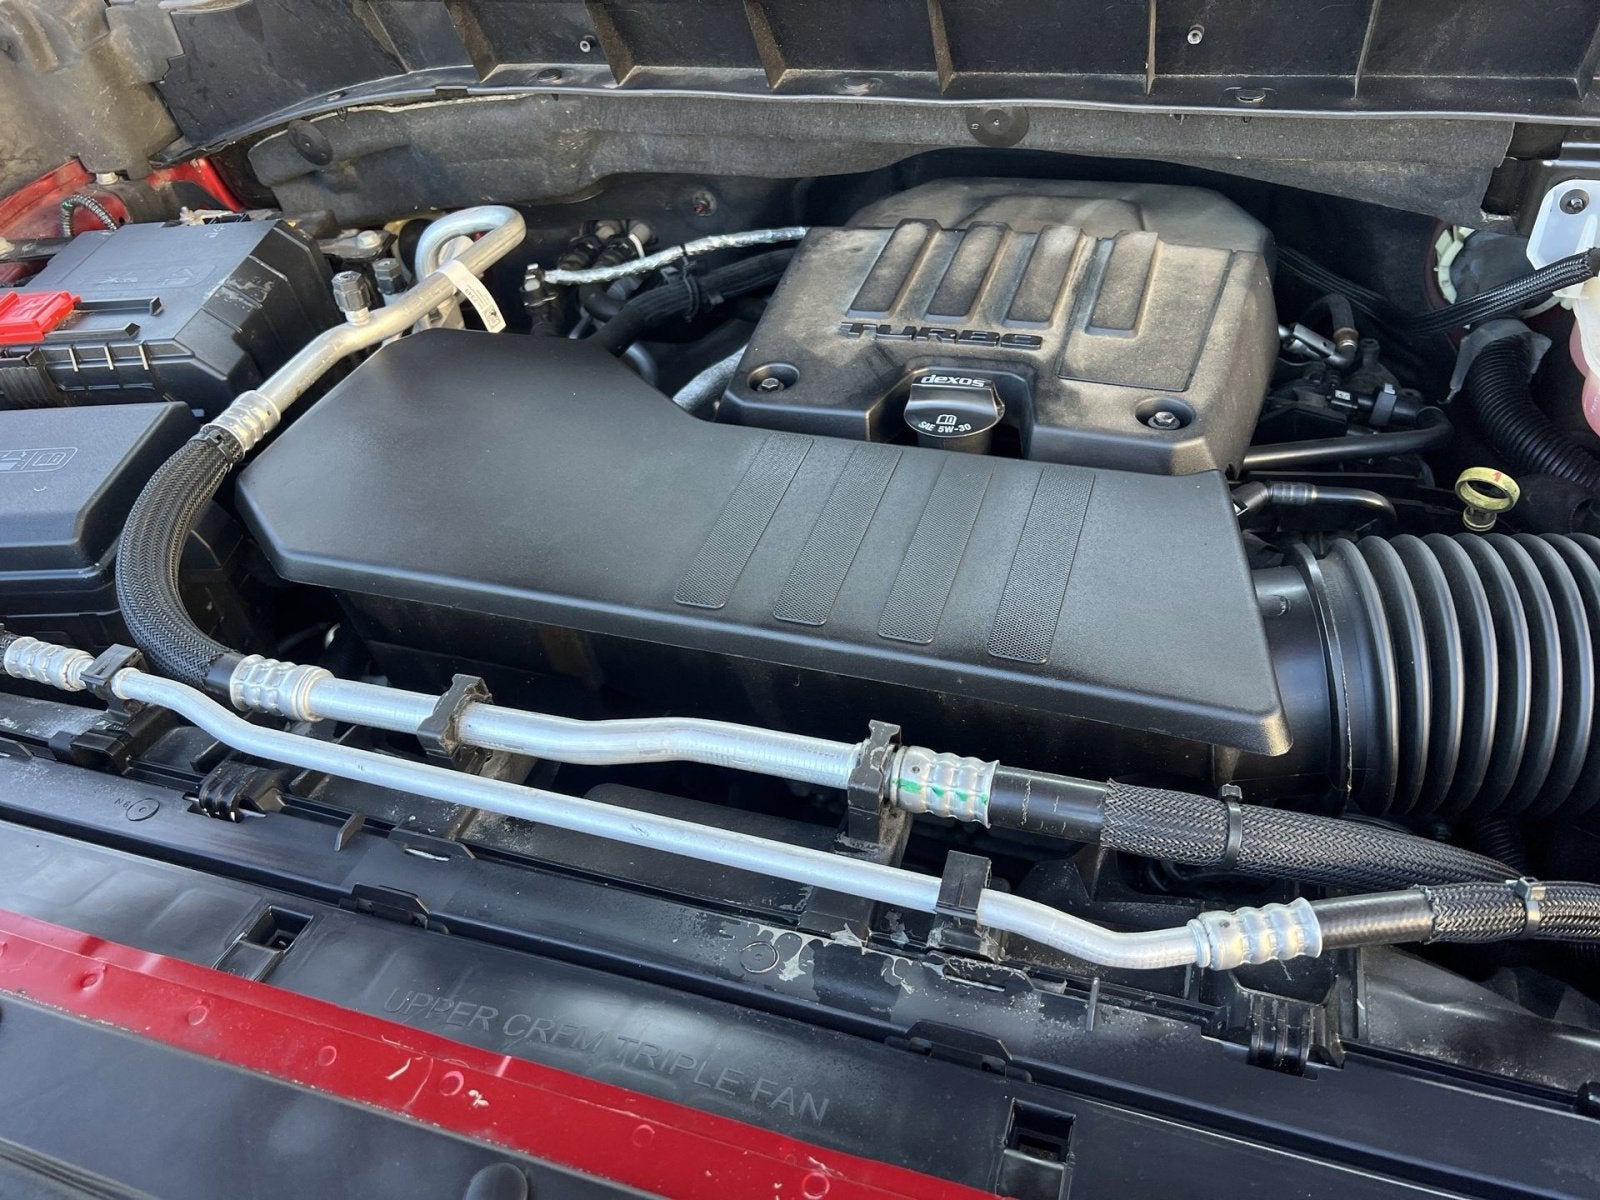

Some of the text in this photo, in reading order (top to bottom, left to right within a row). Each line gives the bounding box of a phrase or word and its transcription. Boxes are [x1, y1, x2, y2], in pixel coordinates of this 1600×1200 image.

[841, 322, 1043, 350] TURBO
[920, 374, 986, 388] dexos
[918, 421, 972, 433] SAE 5W-30
[383, 988, 499, 1033] UPPER
[616, 1035, 745, 1096] TRIPLE
[751, 1078, 830, 1126] FAN
